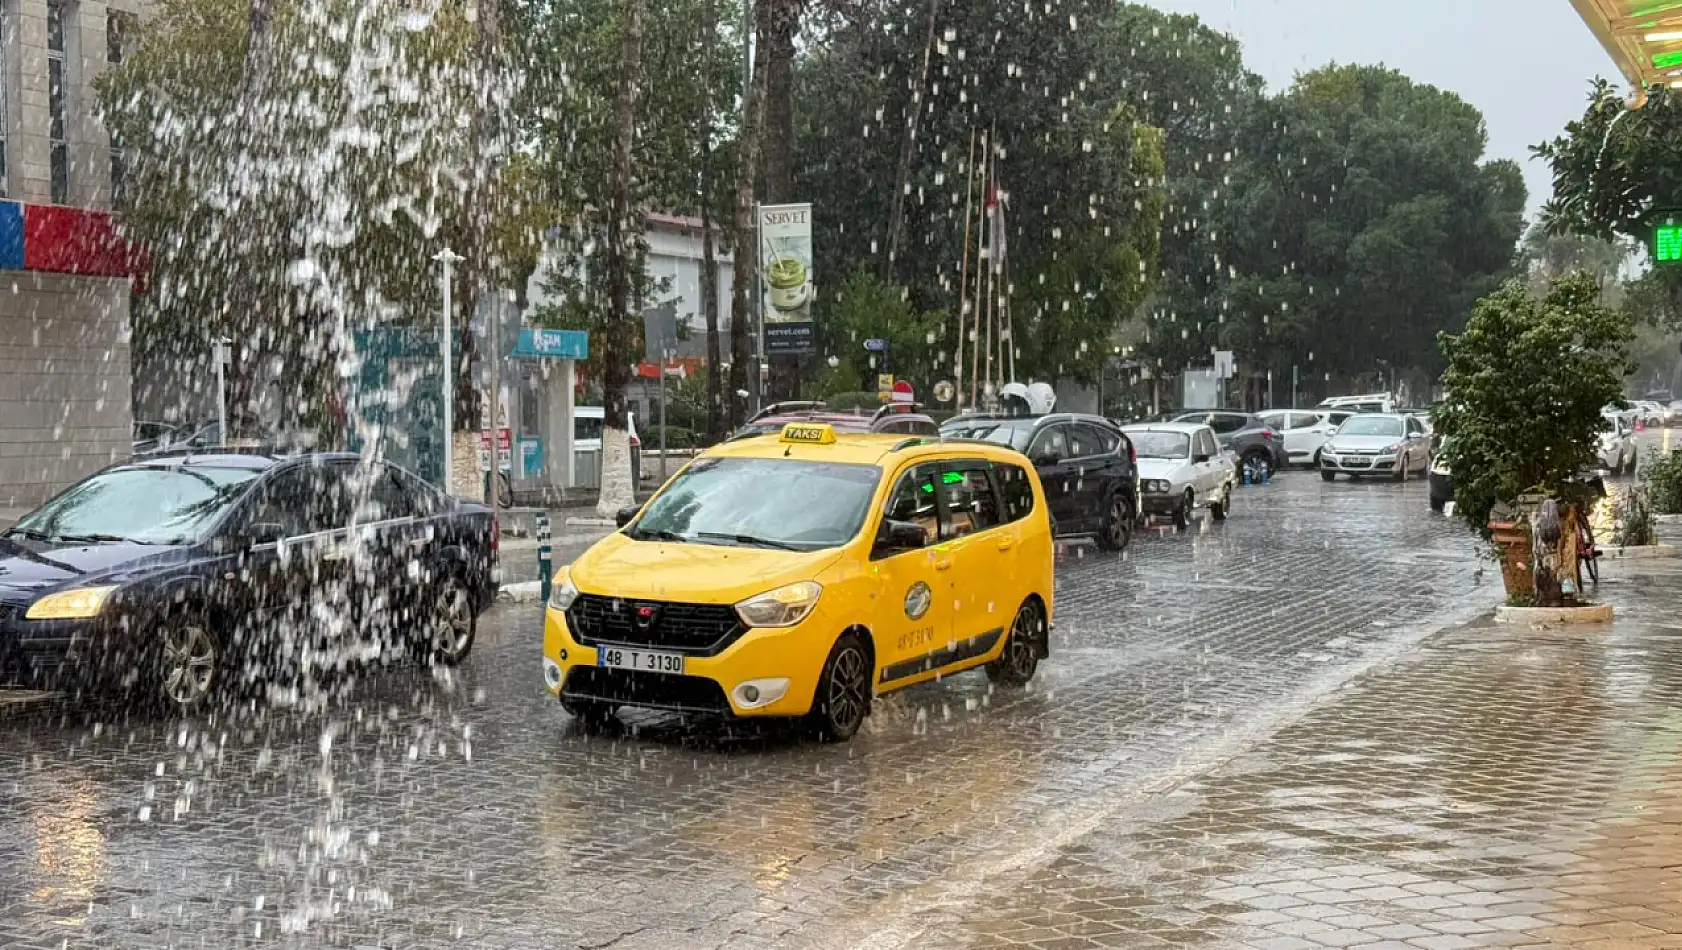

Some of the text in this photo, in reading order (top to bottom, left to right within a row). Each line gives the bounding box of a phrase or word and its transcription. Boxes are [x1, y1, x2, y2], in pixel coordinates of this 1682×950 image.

[765, 211, 806, 226] SERVET
[606, 650, 681, 671] 48 T 3130
